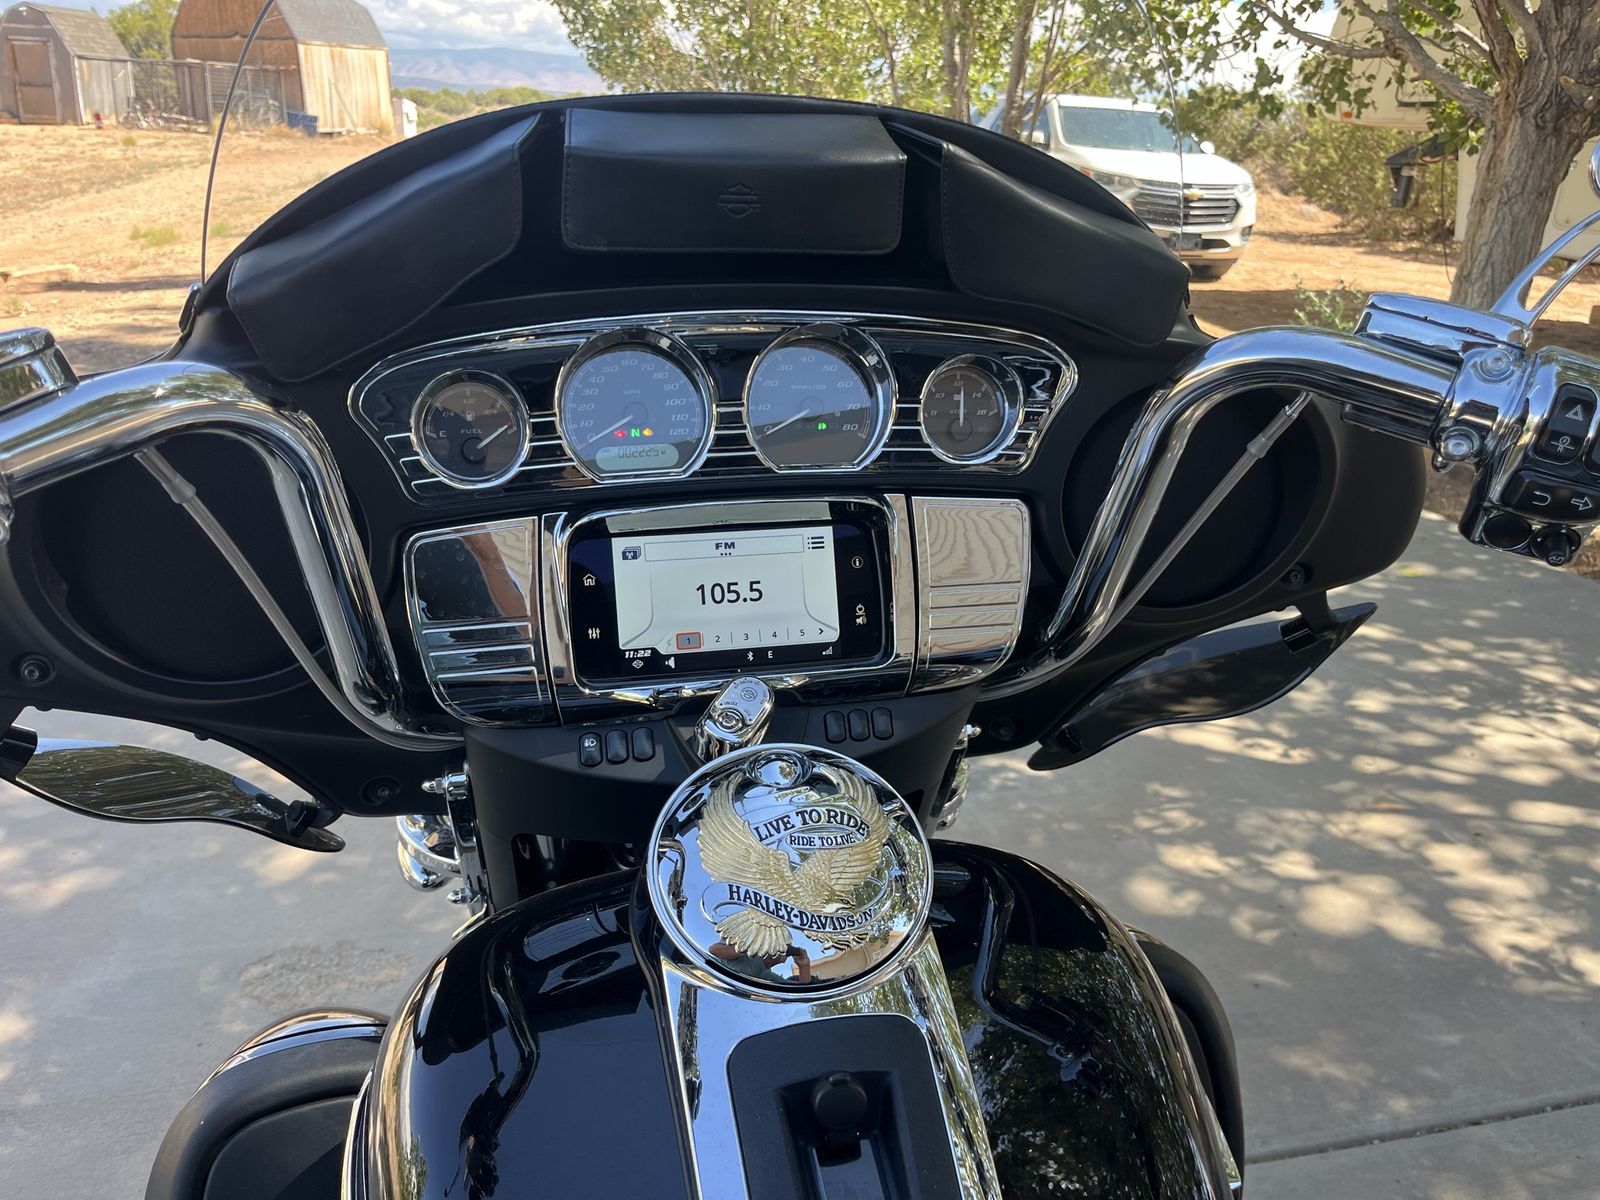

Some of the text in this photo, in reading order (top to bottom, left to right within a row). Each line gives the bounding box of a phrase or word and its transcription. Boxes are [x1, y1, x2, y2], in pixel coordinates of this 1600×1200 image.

[640, 363, 656, 371] 70
[777, 364, 793, 372] 30
[663, 383, 679, 391] 90
[440, 430, 448, 438] E
[631, 428, 640, 438] N
[669, 428, 689, 436] 120
[715, 541, 735, 550] FM
[695, 580, 764, 606] 105.5
[743, 632, 749, 641] 3
[771, 631, 777, 639] 4
[799, 628, 806, 637] 5
[715, 635, 721, 643] 2
[624, 649, 652, 659] 11:22
[767, 650, 774, 659] E
[753, 808, 871, 842] LIVE TO RIDE
[788, 833, 817, 847] RIDE
[817, 836, 835, 847] TO
[728, 883, 874, 931] HARLEY-DAVIDSON
